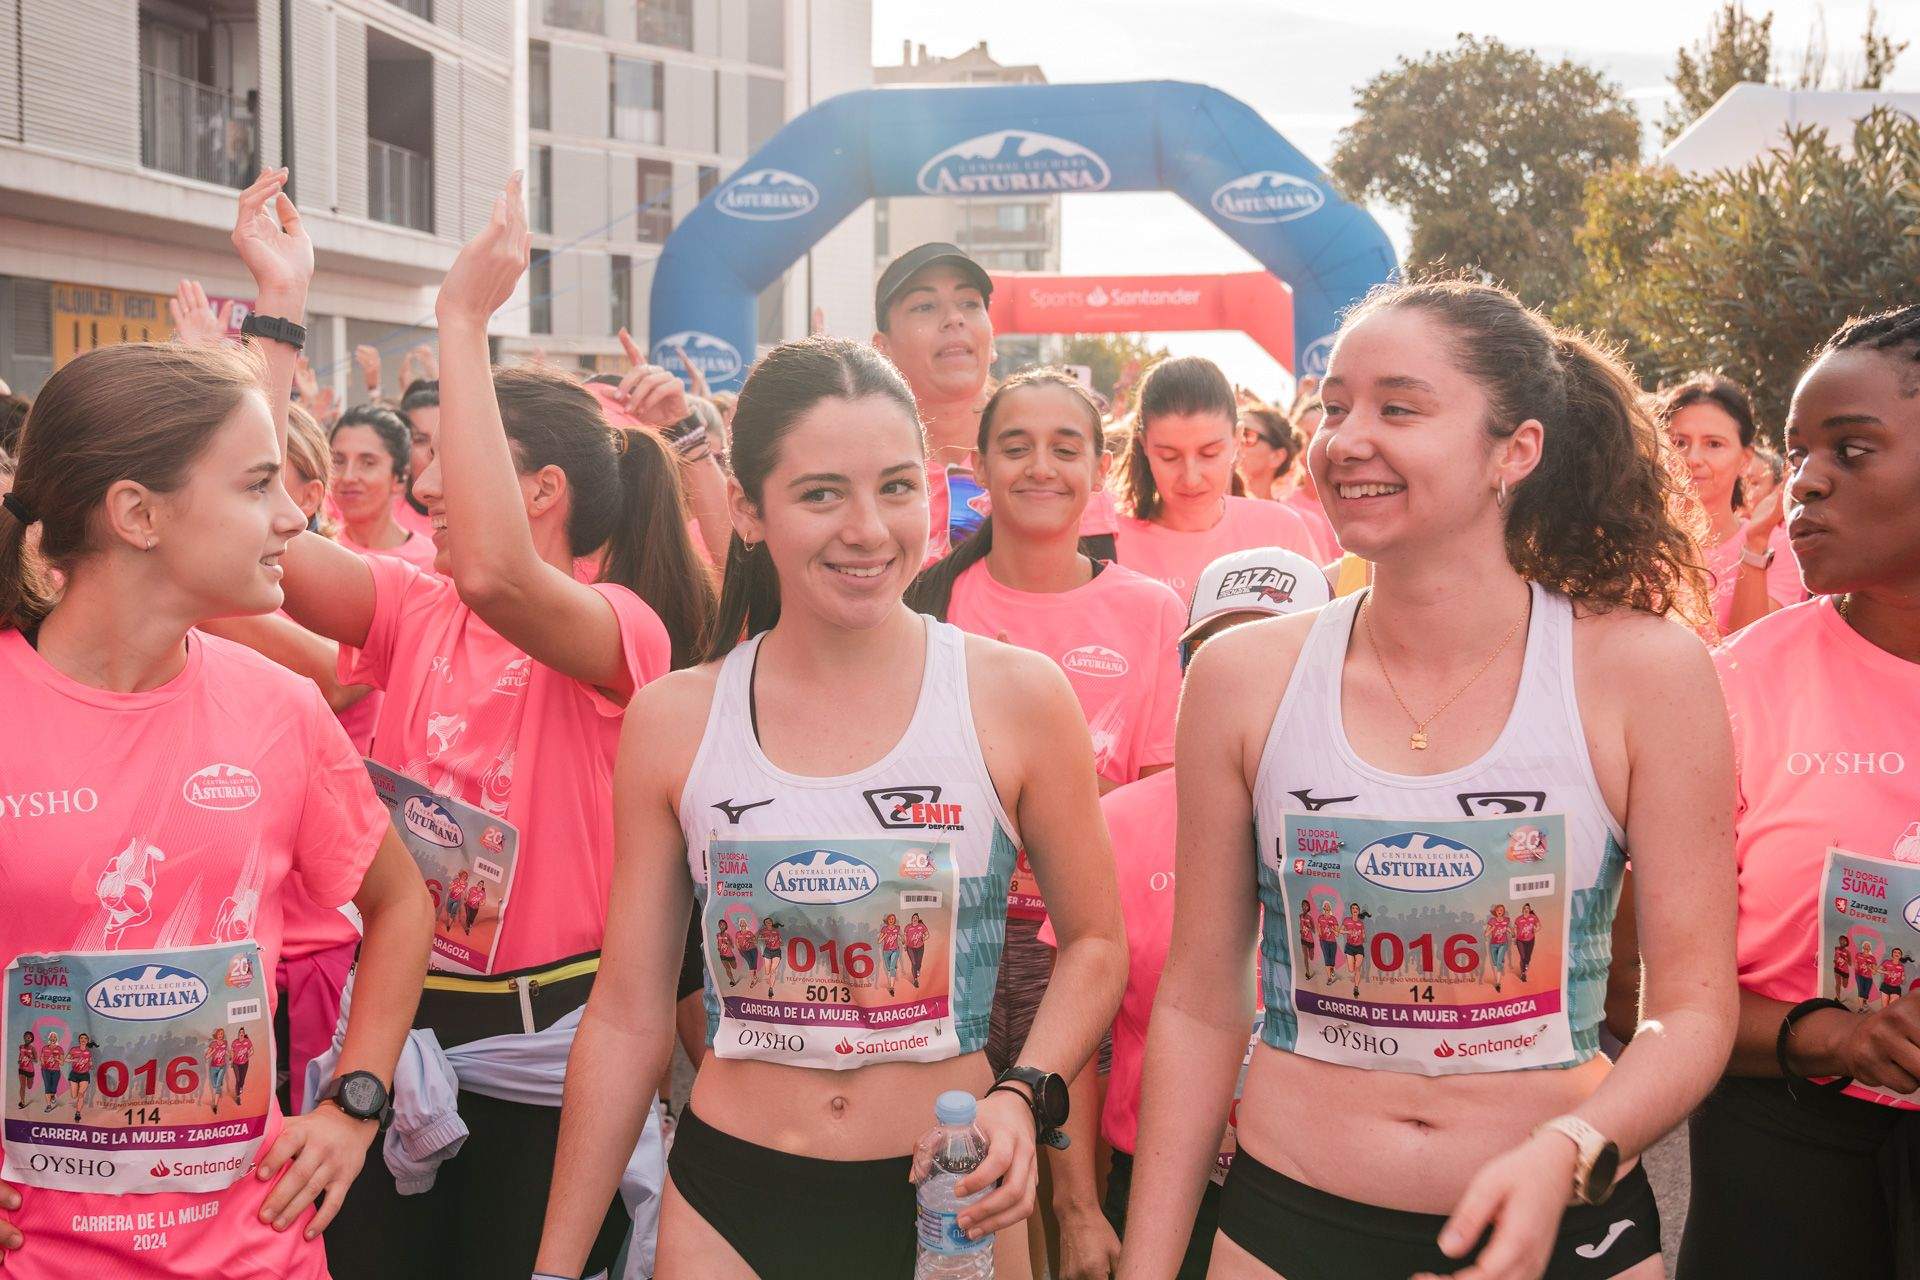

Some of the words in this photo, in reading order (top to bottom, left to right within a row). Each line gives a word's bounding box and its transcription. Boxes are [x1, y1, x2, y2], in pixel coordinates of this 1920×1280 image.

[936, 167, 1098, 192] ASTURIANA
[724, 190, 810, 208] ASTURIANA
[1220, 193, 1316, 212] ASTURIANA
[1029, 288, 1086, 309] Sports
[1110, 287, 1200, 306] Santander
[1069, 654, 1123, 673] ASTURIANA
[1786, 751, 1905, 776] OYSHO
[191, 782, 257, 800] ASTURIANA
[0, 787, 99, 818] YSHO
[405, 801, 459, 845] ASTURIANA
[1297, 829, 1307, 837] TU
[1308, 830, 1340, 839] DORSAL
[1298, 838, 1340, 854] SUMA
[905, 853, 929, 868] 20
[1307, 859, 1341, 871] Zaragoza
[1363, 852, 1476, 878] ASTURIANA
[1382, 852, 1423, 860] CENTRAL
[718, 862, 749, 874] SUMA
[1306, 869, 1341, 879] DEPORTE
[1843, 868, 1854, 877] TU
[1856, 870, 1889, 885] DORSAL
[773, 870, 871, 892] ASTURIANA
[1841, 878, 1887, 899] SUMA
[1849, 909, 1888, 924] DEPORTE
[1850, 900, 1889, 915] Zaragoza
[432, 937, 471, 961] ARAGOZA
[787, 936, 875, 979] 016
[1371, 932, 1480, 973] 016
[231, 957, 250, 977] 20
[24, 973, 69, 987] SUMA
[114, 983, 155, 991] CENTRAL
[34, 992, 72, 1003] Zaragoza
[94, 987, 201, 1008] ASTURIANA
[806, 985, 851, 1003] 5013
[1410, 985, 1435, 1002] 14
[34, 1001, 72, 1011] DEPORTE
[740, 1002, 780, 1018] CARRERA
[784, 1007, 797, 1019] DE
[801, 1008, 815, 1020] LA
[819, 1009, 859, 1022] MUJER
[868, 1004, 929, 1024] ZARAGOZA
[1318, 1000, 1368, 1019] CARRERA
[1372, 1008, 1388, 1020] DE
[1393, 1009, 1408, 1022] LA
[1412, 1010, 1458, 1023] MUJER
[1471, 1000, 1537, 1022] ZARAGOZA
[738, 1029, 805, 1052] OYSHO
[856, 1035, 929, 1055] Santander
[1323, 1025, 1399, 1056] OYSHO
[1458, 1034, 1538, 1057] Santander
[97, 1056, 200, 1097] 016
[124, 1107, 161, 1125] 114
[31, 1127, 88, 1142] CARRERA
[92, 1132, 108, 1144] DE
[112, 1132, 127, 1144] LA
[132, 1131, 176, 1144] MUJER
[188, 1123, 248, 1142] ZARAGOZA
[30, 1153, 115, 1177] OYSHO
[173, 1157, 246, 1176] Santander
[72, 1214, 133, 1232] CARRERA
[138, 1213, 155, 1229] DE
[159, 1211, 176, 1227] LA
[179, 1201, 219, 1224] MUJER
[133, 1232, 167, 1251] 2024
